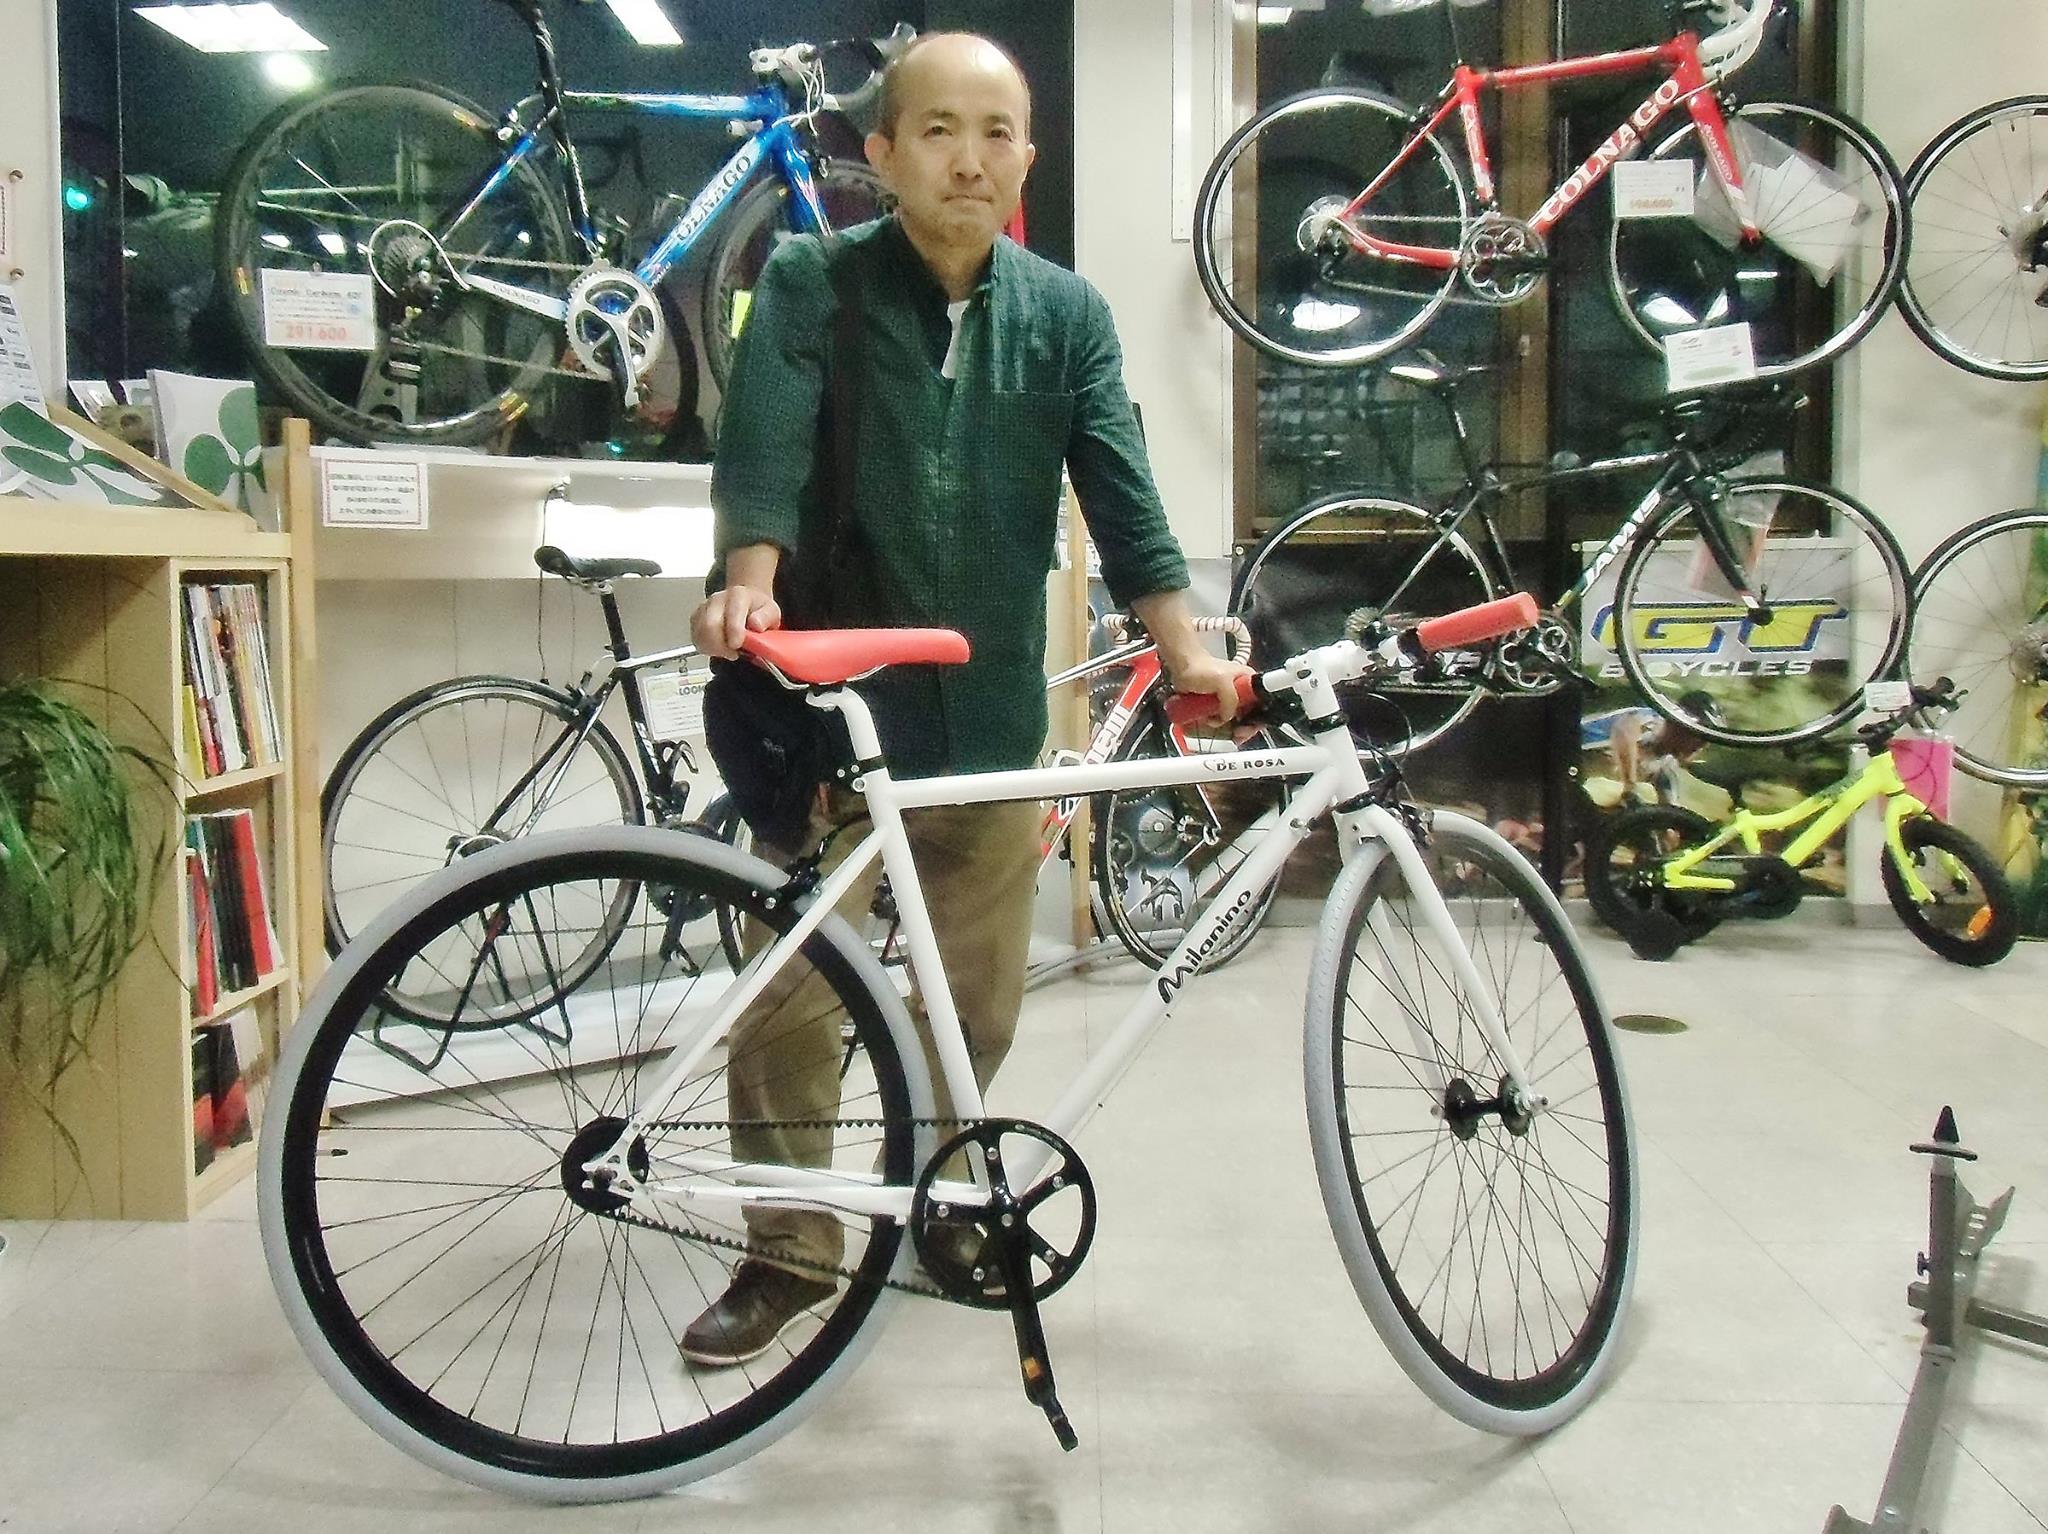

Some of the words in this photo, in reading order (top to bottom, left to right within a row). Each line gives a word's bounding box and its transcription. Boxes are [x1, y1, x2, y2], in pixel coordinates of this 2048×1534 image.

[1541, 80, 1679, 221] COLNAGO
[677, 156, 751, 240] OLNAGO
[1580, 487, 1661, 596] JAMIS
[1591, 598, 1848, 654] GT
[1600, 660, 1813, 678] BCYCLES
[1243, 758, 1286, 769] ROSA
[1157, 890, 1251, 1004] Milanino
